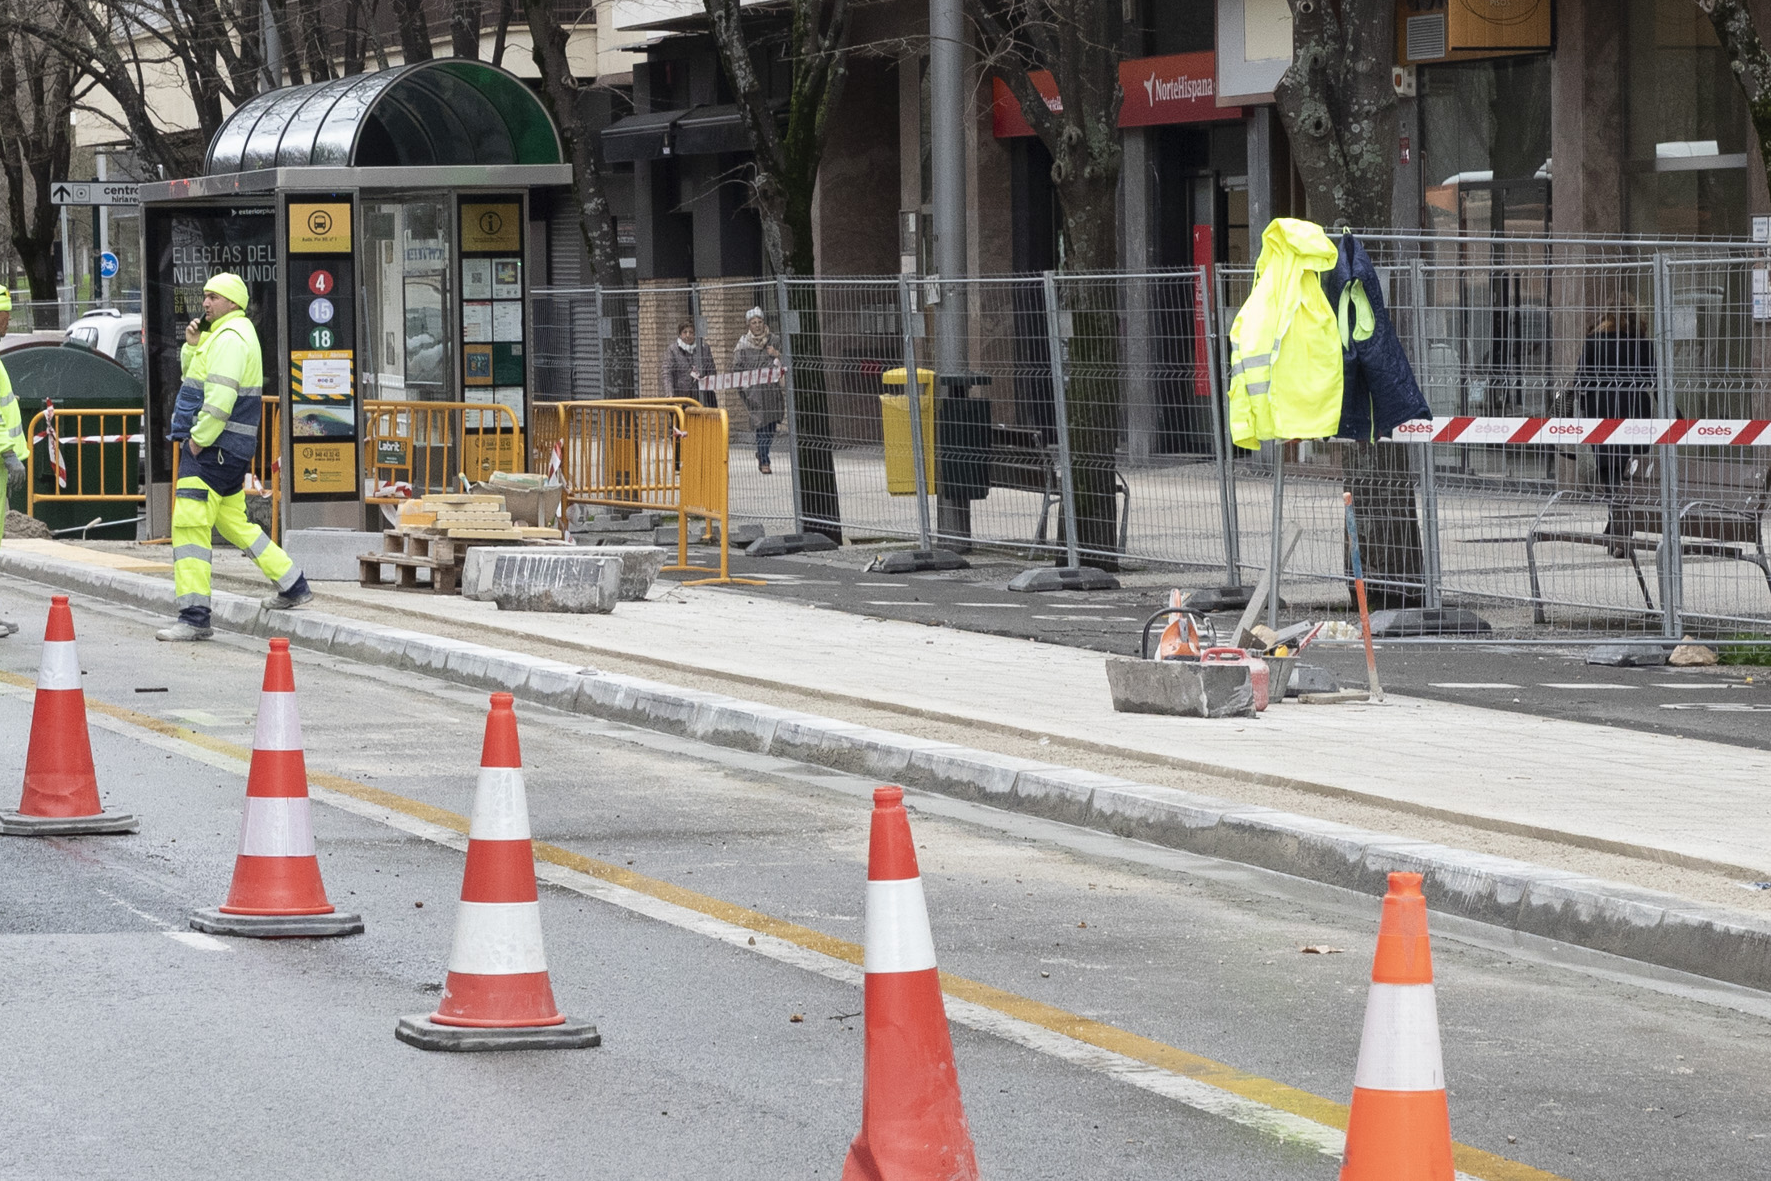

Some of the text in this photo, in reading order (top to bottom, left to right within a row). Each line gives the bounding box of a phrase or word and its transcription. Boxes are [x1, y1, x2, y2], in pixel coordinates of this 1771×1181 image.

[1155, 75, 1213, 102] NorteHispana
[238, 208, 276, 216] exteriorplus
[172, 241, 276, 264] ELEGÍAS DEL
[173, 287, 203, 295] ORQUES
[315, 274, 325, 292] 4
[174, 294, 204, 304] SINFÓN
[174, 305, 184, 314] DE
[312, 302, 330, 320] 15
[312, 330, 331, 348] 18
